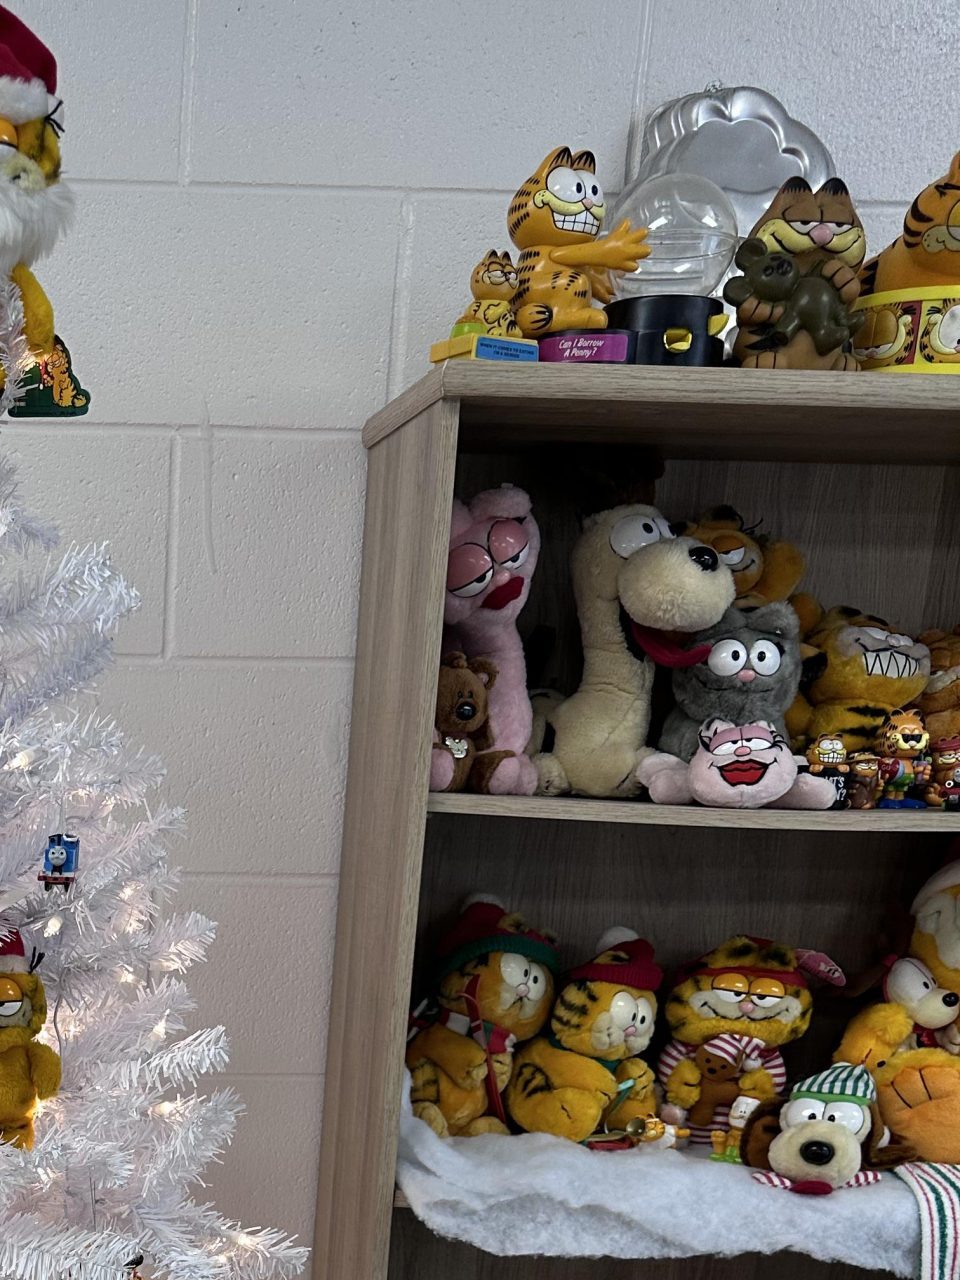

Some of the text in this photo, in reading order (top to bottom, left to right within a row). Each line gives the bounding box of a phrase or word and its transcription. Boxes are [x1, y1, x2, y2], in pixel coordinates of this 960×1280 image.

[559, 340, 572, 349] Can
[578, 338, 605, 347] Borrow
[564, 349, 570, 358] A
